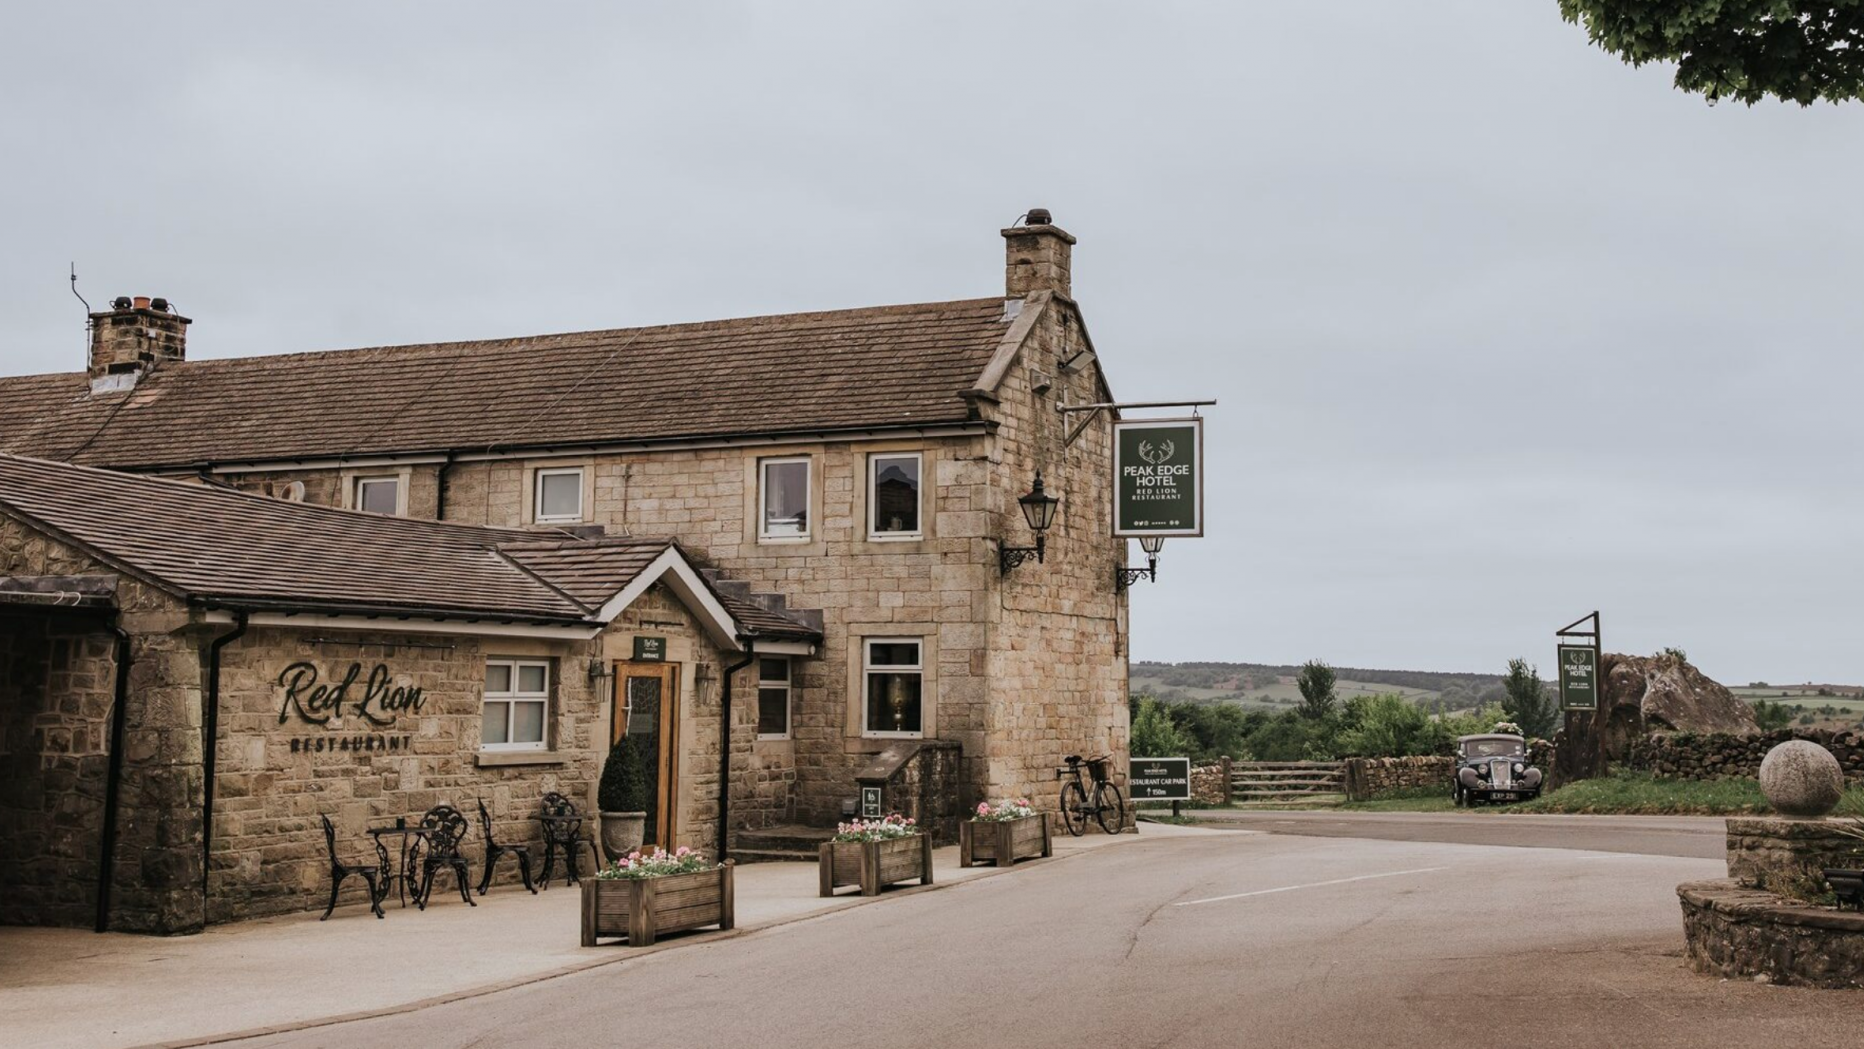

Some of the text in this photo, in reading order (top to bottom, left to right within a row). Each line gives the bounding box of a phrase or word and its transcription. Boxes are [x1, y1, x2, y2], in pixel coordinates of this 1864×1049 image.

[1124, 465, 1189, 476] PEAK EDGE
[1136, 476, 1176, 486] HOTEL
[278, 662, 427, 725] Red Lion
[290, 735, 411, 753] RESTAURANT
